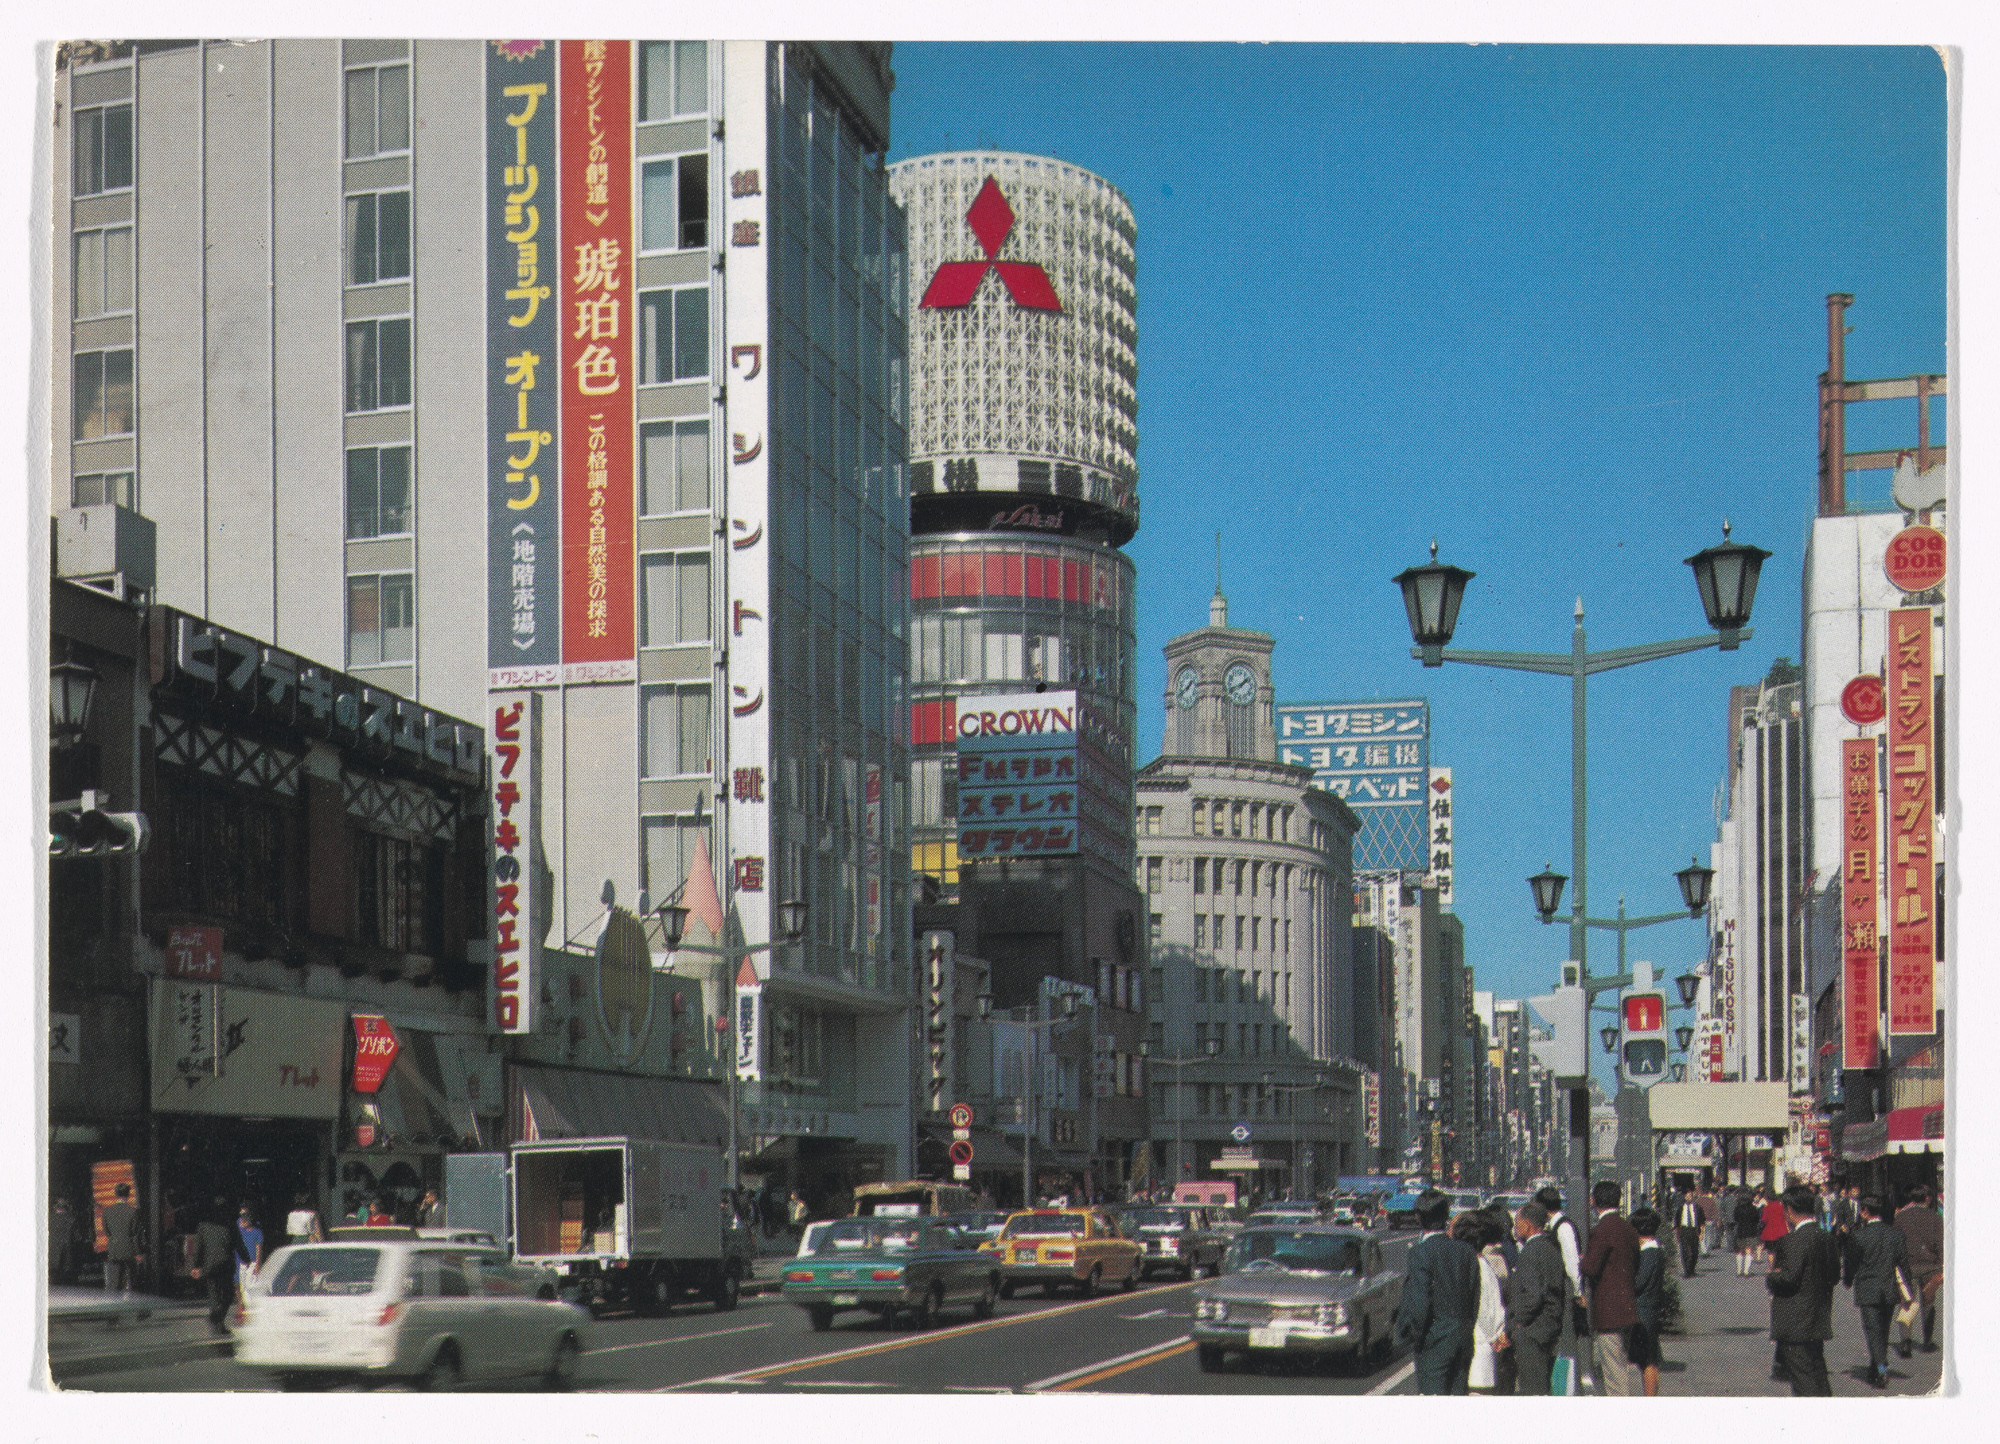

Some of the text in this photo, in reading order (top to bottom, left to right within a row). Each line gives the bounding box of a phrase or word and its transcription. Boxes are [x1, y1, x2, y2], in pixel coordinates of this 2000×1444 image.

[730, 169, 762, 249] 銀座
[573, 238, 621, 395] 琥珀色
[504, 350, 552, 510] オープン
[958, 706, 1074, 738] CROWN
[1282, 711, 1420, 736] トヨタミシン
[1282, 743, 1419, 768] トヨタ編機
[961, 790, 1075, 817] ステレオ
[1849, 750, 1871, 840] お菓子の
[1894, 624, 1928, 928] レストラン コックドール
[494, 701, 524, 1030] ビフテキのスエヒロ
[959, 825, 1075, 853] クラウン
[1432, 798, 1452, 895] 住友銀行
[1725, 919, 1736, 1047] MITSUKOSHI
